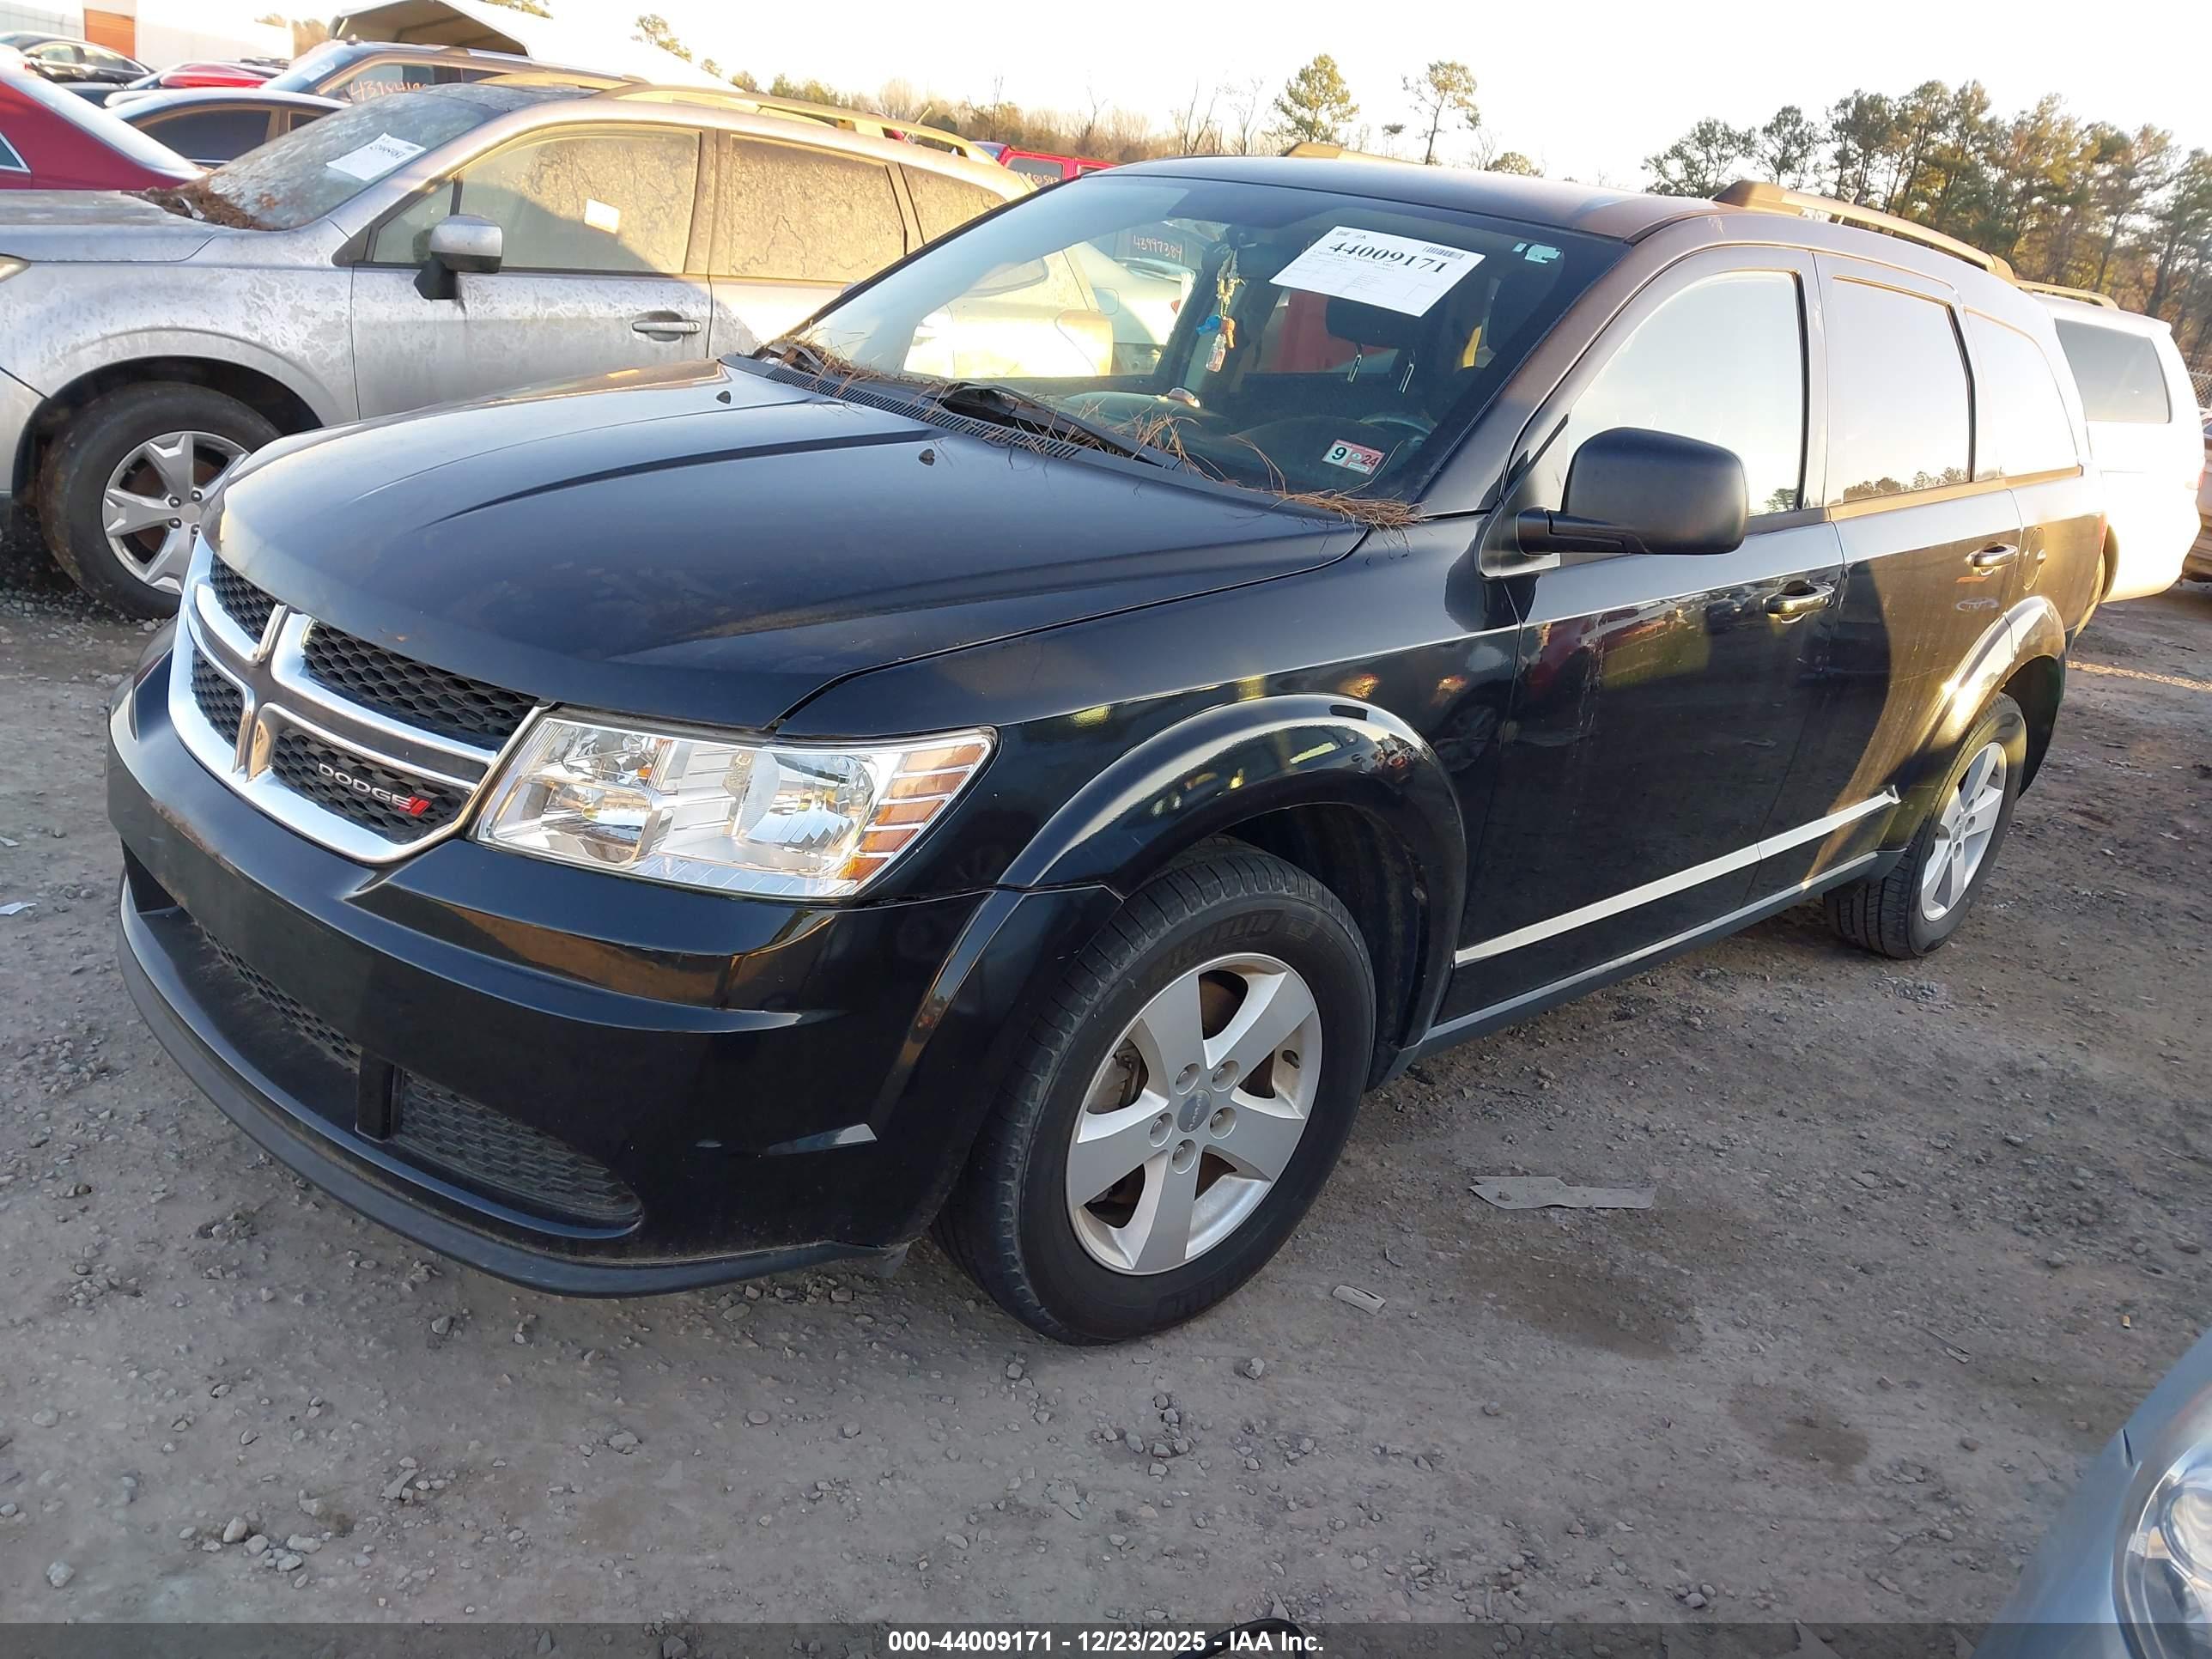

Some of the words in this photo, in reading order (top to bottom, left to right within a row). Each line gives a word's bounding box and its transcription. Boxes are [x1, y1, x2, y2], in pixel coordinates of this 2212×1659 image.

[1133, 233, 1182, 262] 43997384
[1328, 241, 1449, 273] 44009171
[1331, 447, 1347, 460] 9
[1360, 454, 1379, 467] 24
[318, 762, 412, 811] DODGE
